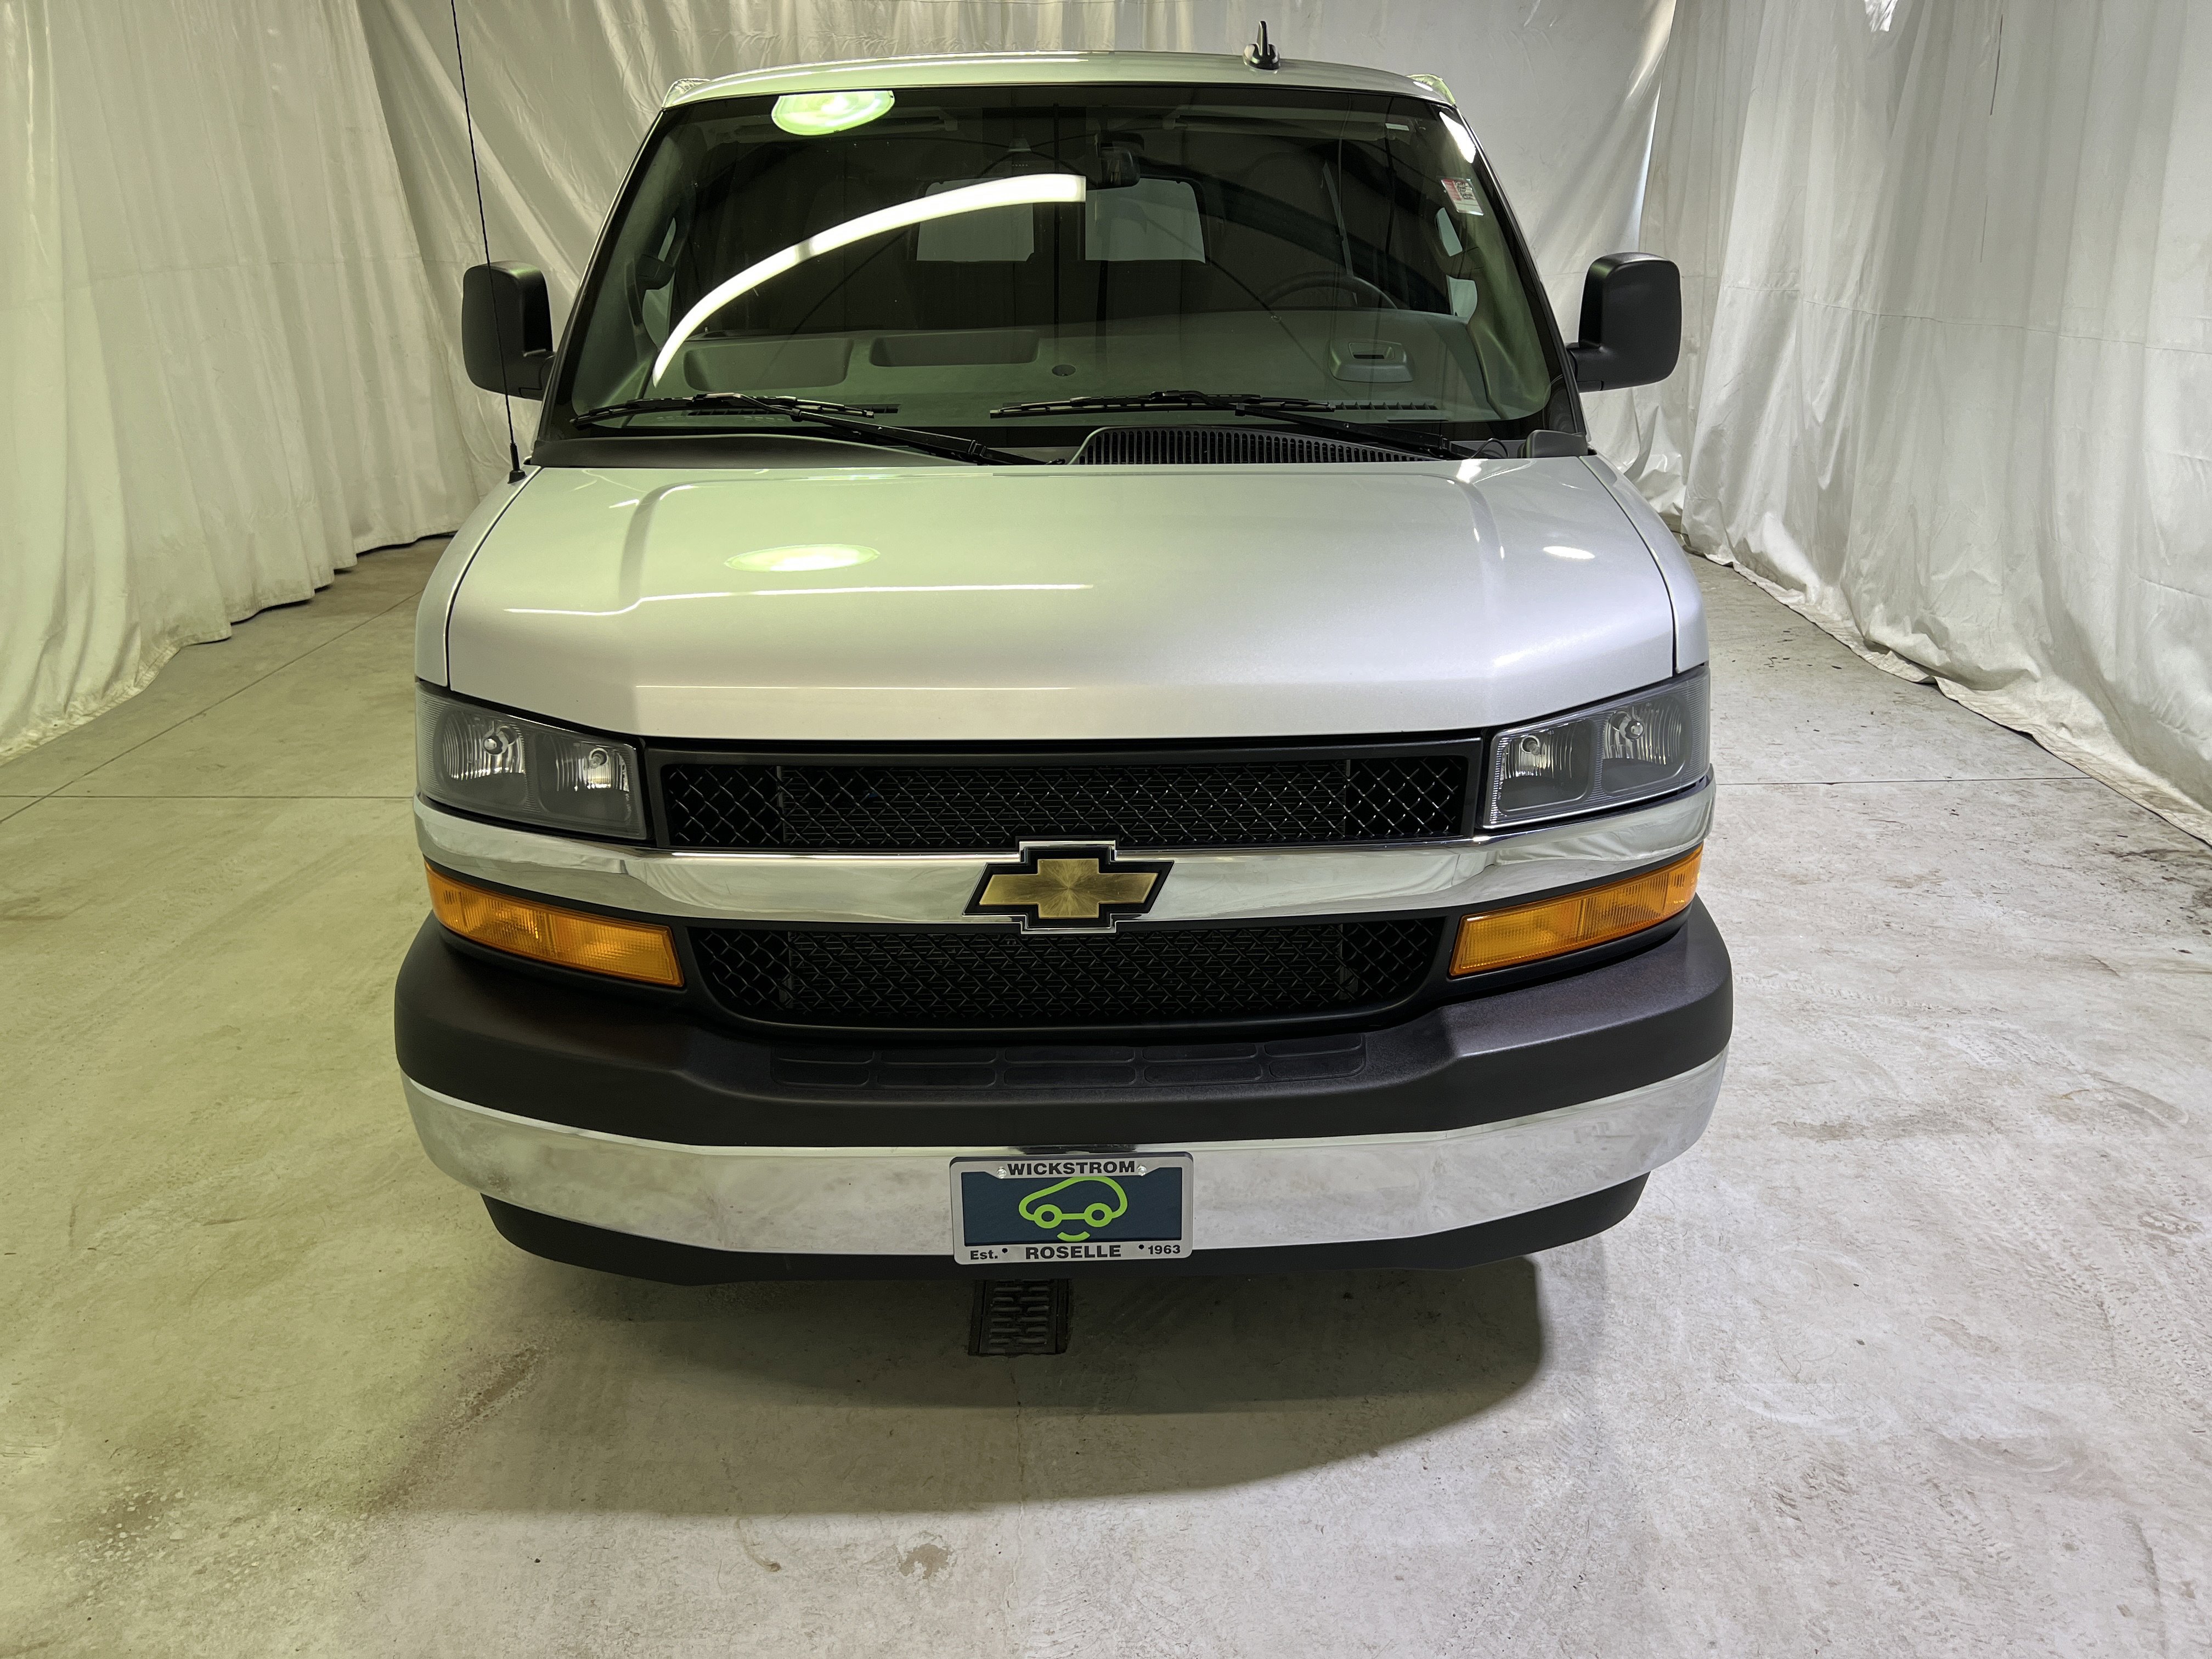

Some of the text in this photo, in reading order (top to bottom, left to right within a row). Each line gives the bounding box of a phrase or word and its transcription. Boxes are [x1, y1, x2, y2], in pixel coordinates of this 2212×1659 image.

[1007, 1160, 1135, 1176] WICKSTROM
[970, 1244, 1181, 1260] Est. ROSELLE 1963
